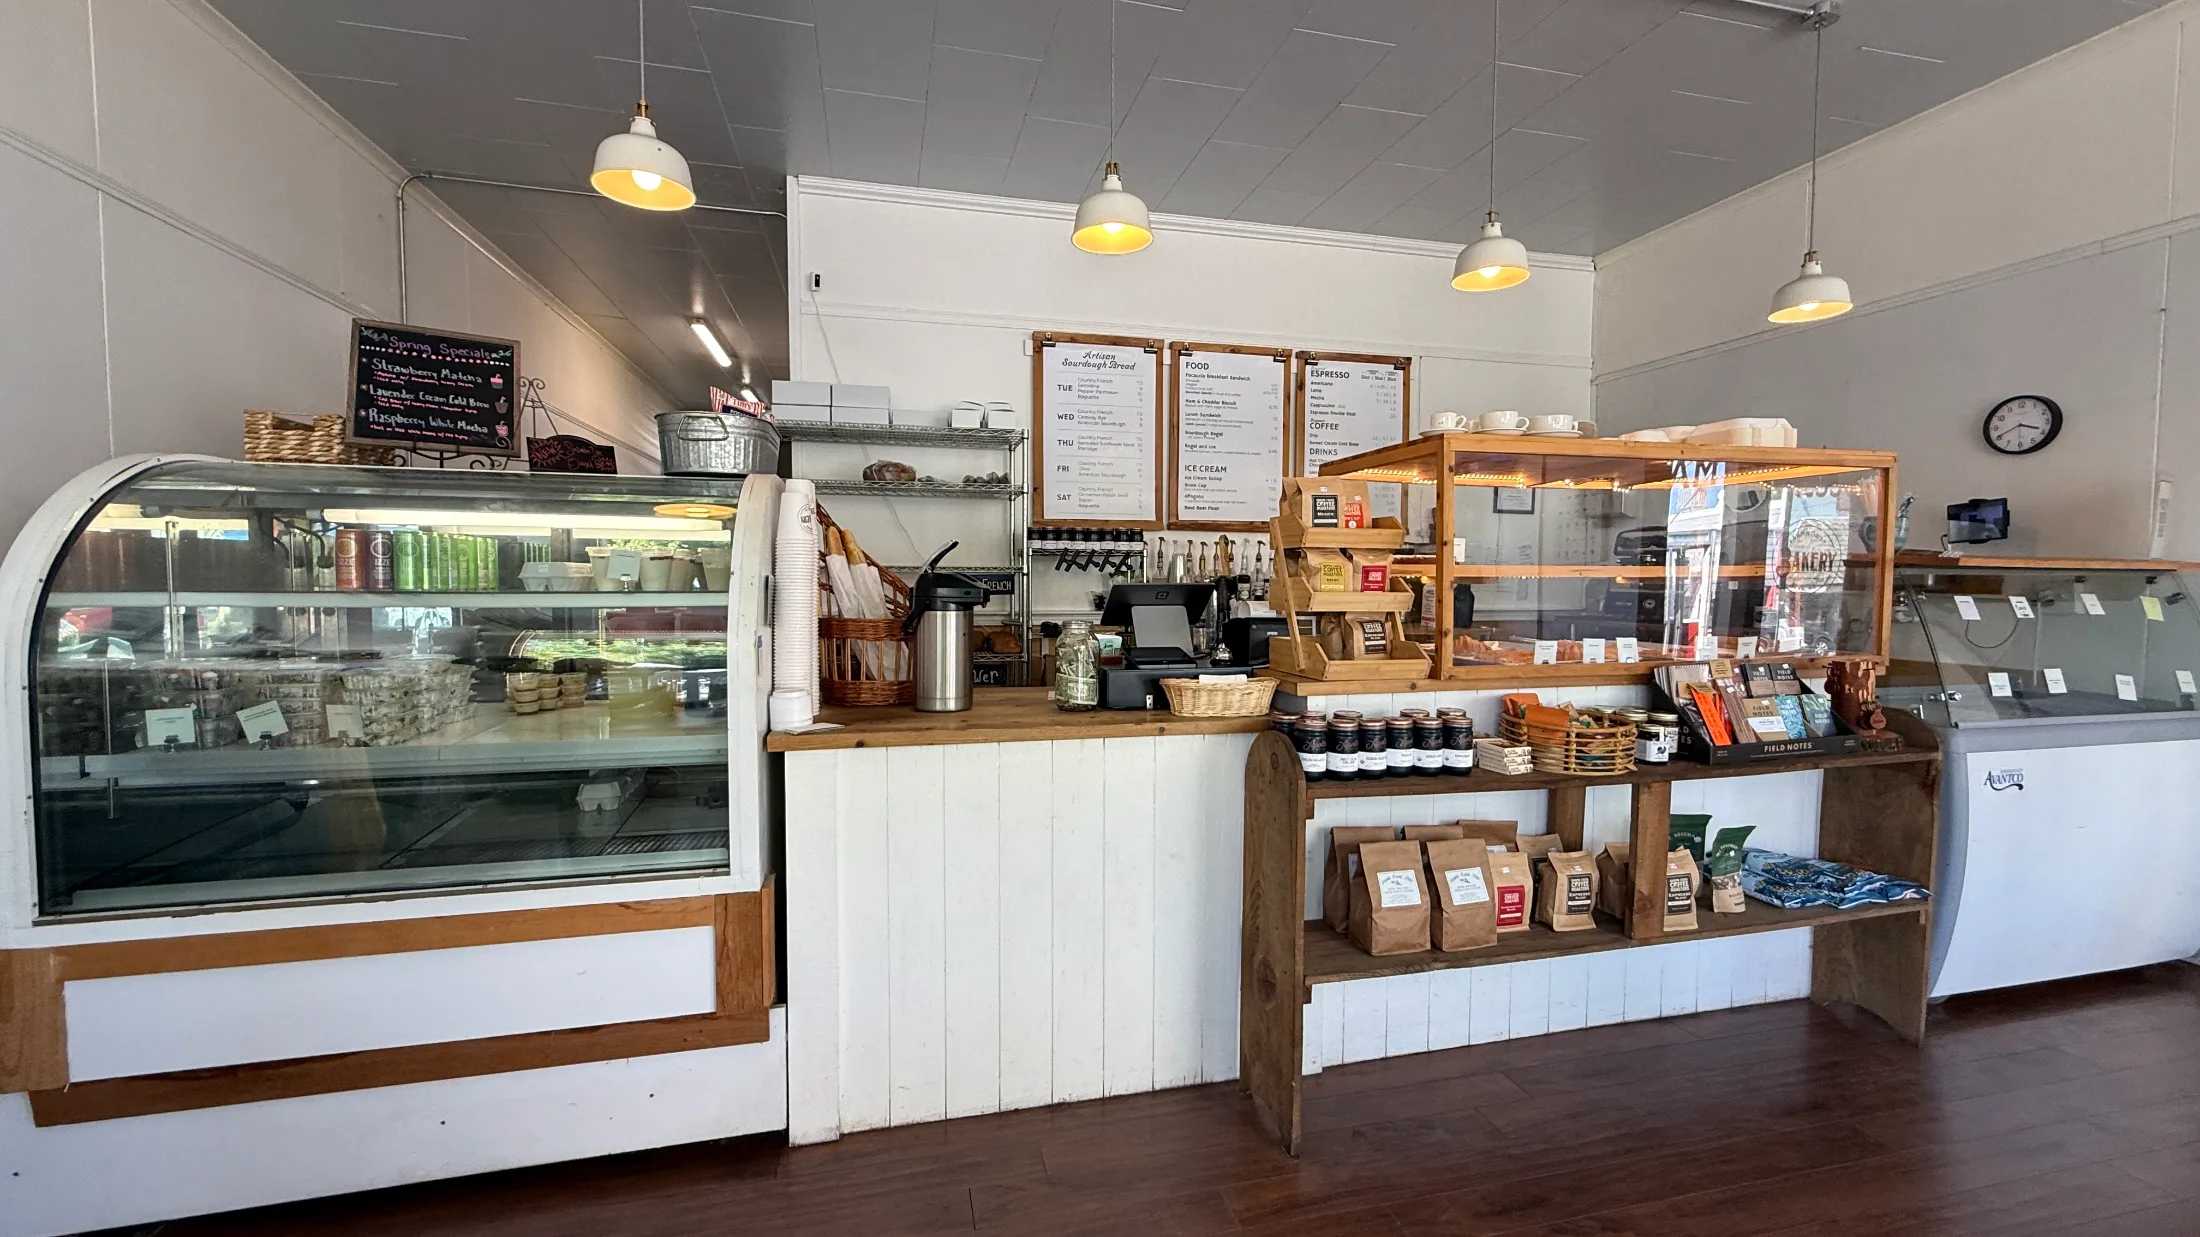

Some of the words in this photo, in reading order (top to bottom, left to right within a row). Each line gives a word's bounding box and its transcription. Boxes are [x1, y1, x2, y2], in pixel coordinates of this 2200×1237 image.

[389, 337, 431, 355] Spring
[440, 343, 491, 360] Specials
[1083, 351, 1116, 360] Artisan
[372, 358, 437, 379] Strawberry
[441, 369, 482, 383] Matcha
[1062, 358, 1107, 370] Sourdough
[1108, 361, 1136, 370] Bread
[1186, 362, 1209, 370] FOOD
[1311, 370, 1350, 379] ESPRESSO
[370, 385, 414, 400] Lavender
[419, 391, 447, 402] Cream
[450, 396, 466, 406] Cold
[469, 398, 489, 408] Brew
[368, 408, 425, 428] Raspberry
[429, 416, 454, 429] White
[457, 421, 488, 434] Mocha
[1310, 422, 1339, 430] COFFEE
[1791, 552, 1837, 572] AKERY
[982, 578, 1012, 591] FRENCH
[1764, 744, 1785, 752] FIELD
[1787, 742, 1812, 751] NOTES
[1983, 771, 2024, 786] AVANTCO
